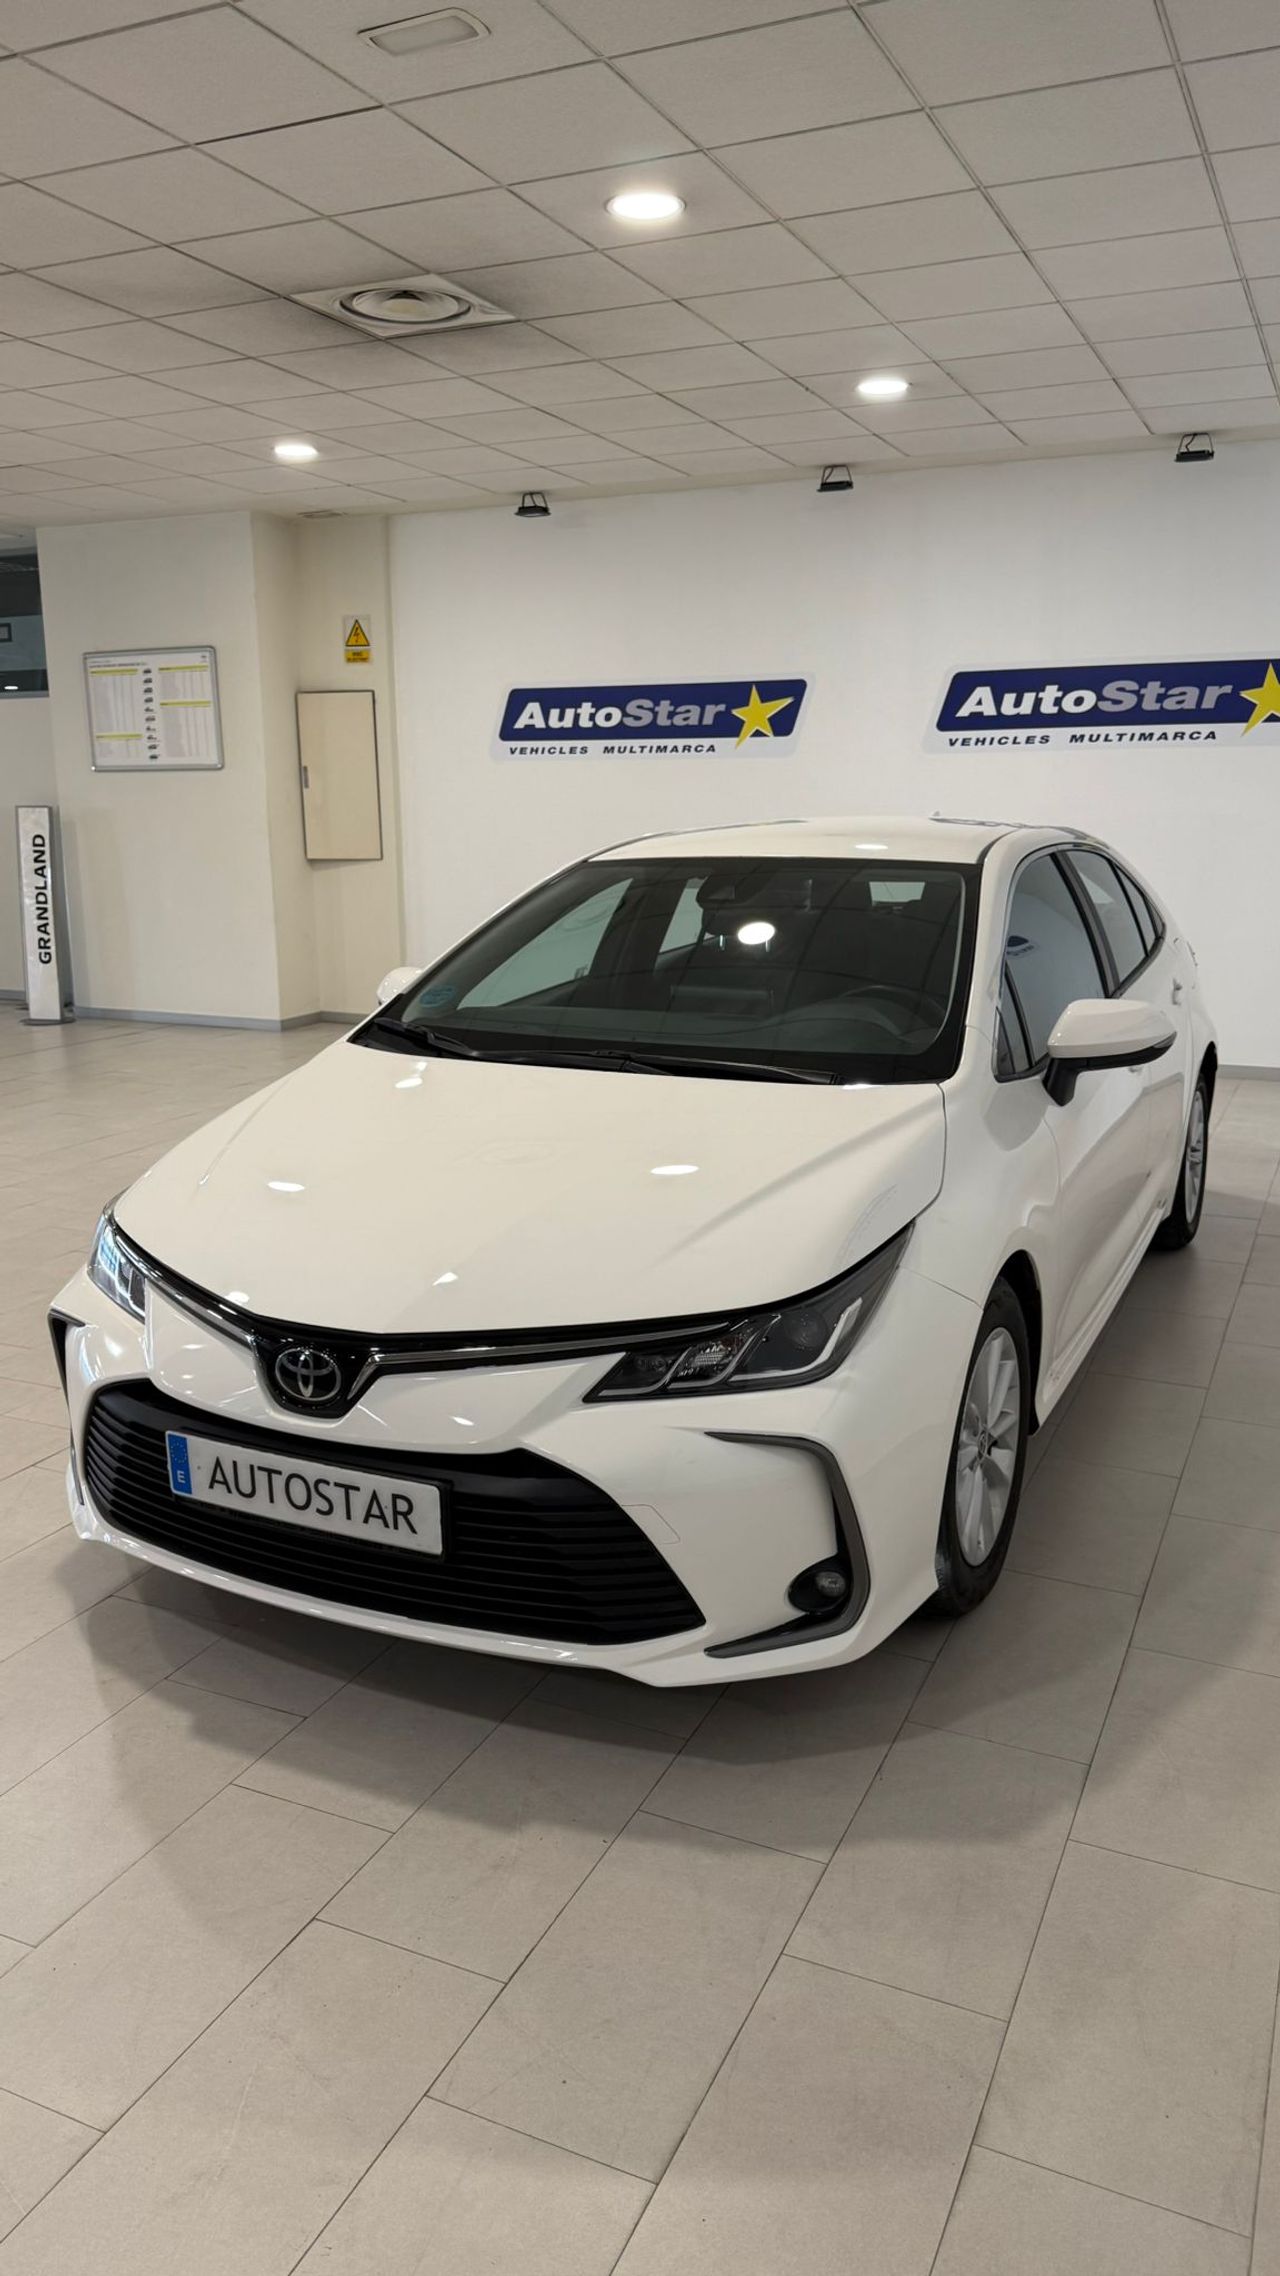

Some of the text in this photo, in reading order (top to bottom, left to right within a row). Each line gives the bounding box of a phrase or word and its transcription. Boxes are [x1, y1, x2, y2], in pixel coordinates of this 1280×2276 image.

[513, 698, 727, 729] AutoStar
[955, 680, 1234, 717] AutoStar
[509, 744, 717, 756] VEHICLES MULTIMARCA
[948, 731, 1217, 747] VEHICLES MULTIMARCA
[32, 834, 52, 965] GRANDLAND
[177, 1456, 418, 1534] E AUTOSTAR
